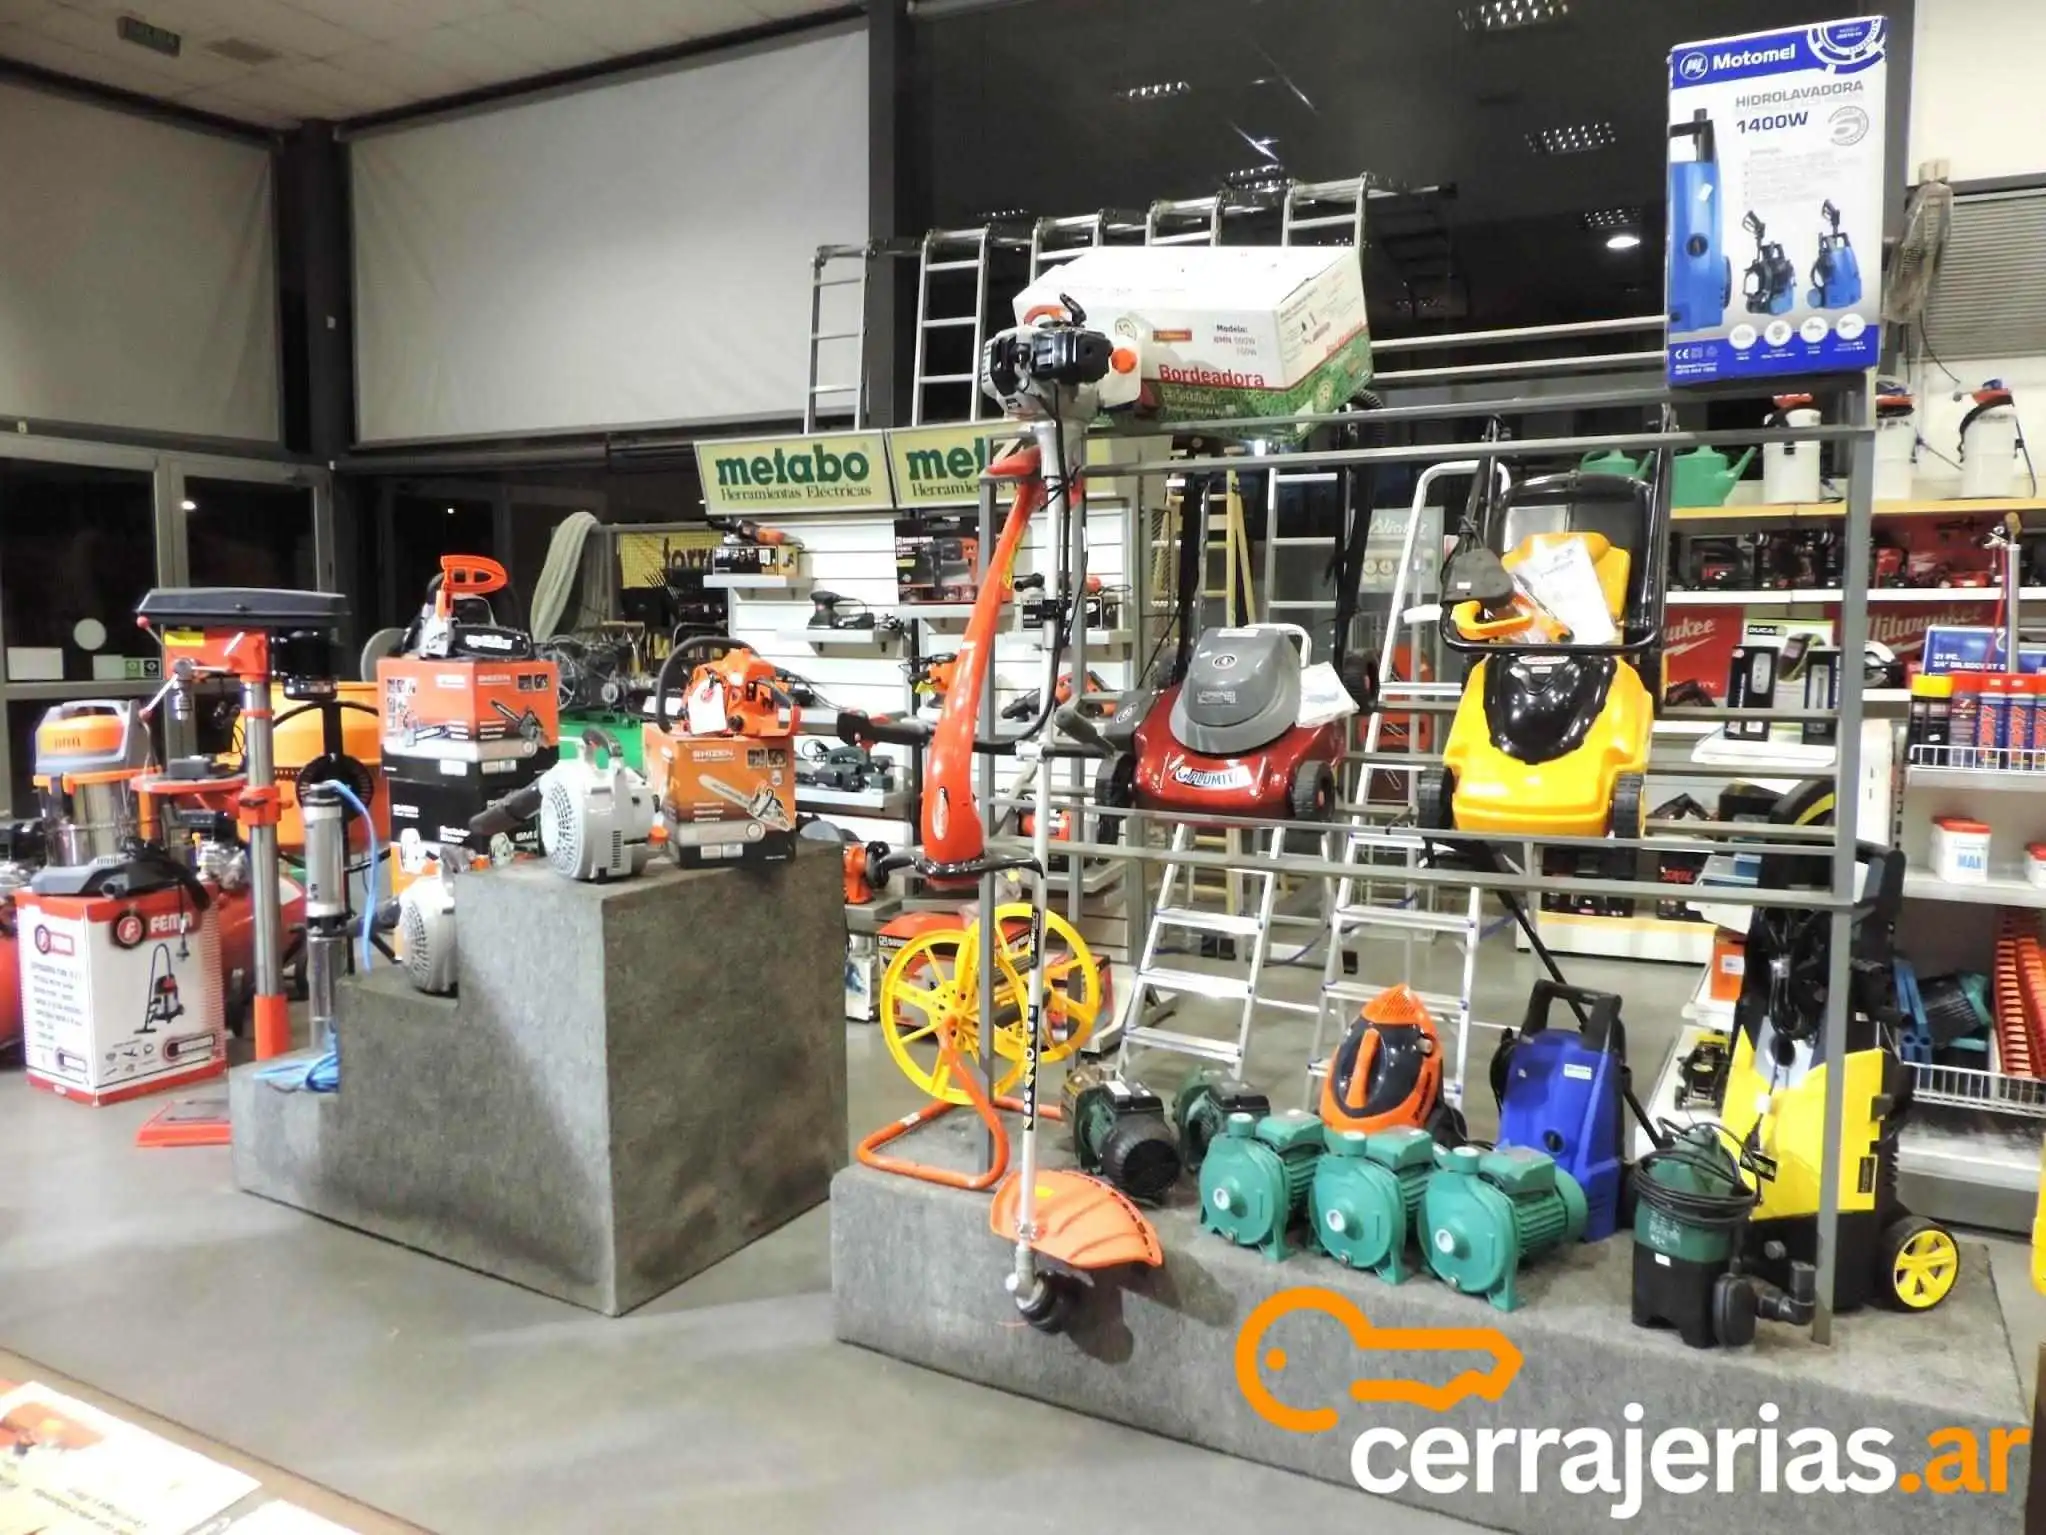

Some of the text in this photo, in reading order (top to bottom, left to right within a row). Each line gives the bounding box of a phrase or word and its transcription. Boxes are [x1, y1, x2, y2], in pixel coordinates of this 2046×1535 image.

[1713, 44, 1796, 71] Motomel
[1736, 80, 1864, 108] HIDROLAVADORA
[1737, 111, 1809, 135] 1400W
[1158, 364, 1265, 387] Bordeadora
[715, 444, 870, 485] metabo
[906, 437, 986, 480] met
[721, 486, 802, 500] Herramientas
